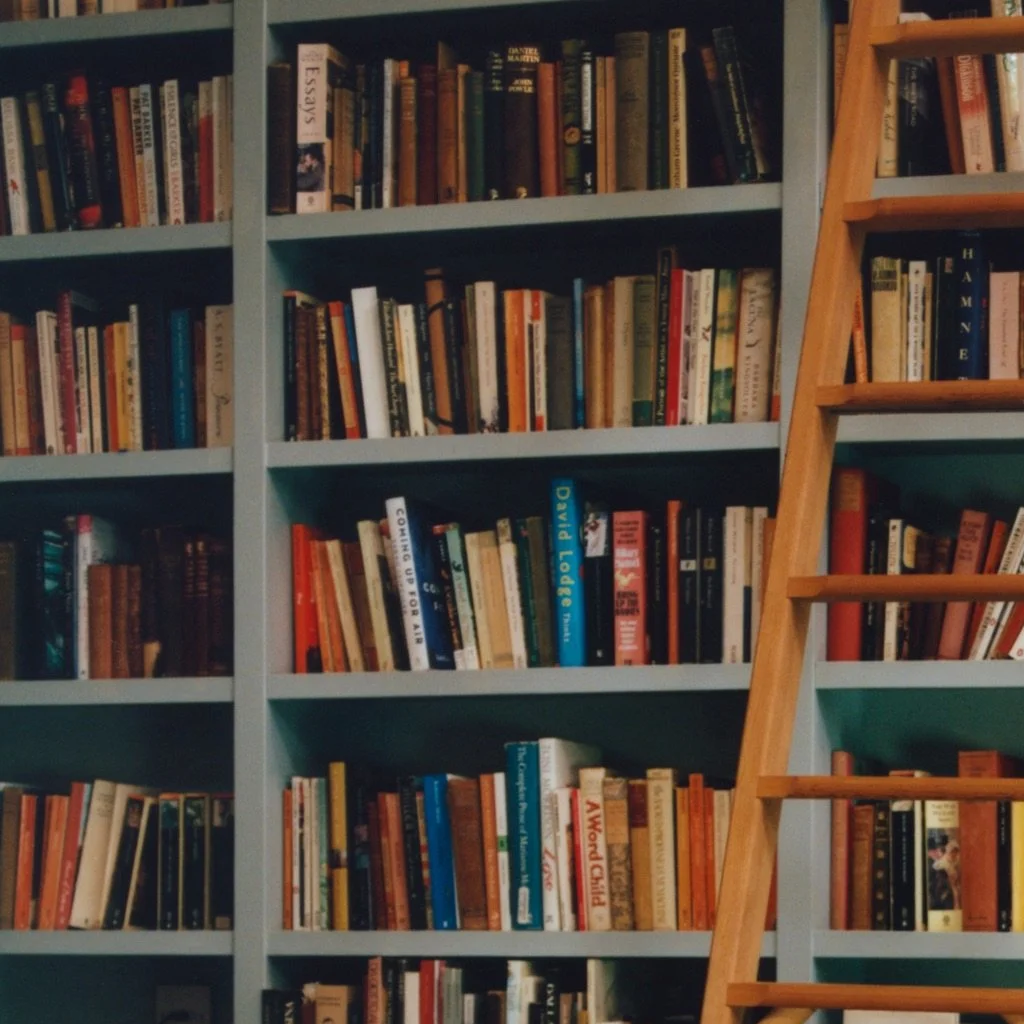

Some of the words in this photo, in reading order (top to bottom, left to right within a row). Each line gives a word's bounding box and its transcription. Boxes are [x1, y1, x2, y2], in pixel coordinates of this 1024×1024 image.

[132, 98, 142, 115] PAT
[139, 92, 150, 107] PAT
[300, 65, 321, 125] Essays
[133, 118, 144, 156] BARKER
[141, 111, 152, 148] BARKER
[555, 486, 571, 540] David
[395, 508, 411, 562] COMING
[404, 568, 414, 585] UP
[556, 551, 574, 608] Lodge
[408, 591, 419, 616] FOR
[518, 746, 528, 762] The
[515, 763, 528, 801] Complete
[519, 802, 528, 822] Prose
[585, 800, 600, 814] A
[586, 815, 603, 863] Word
[590, 864, 606, 908] Child
